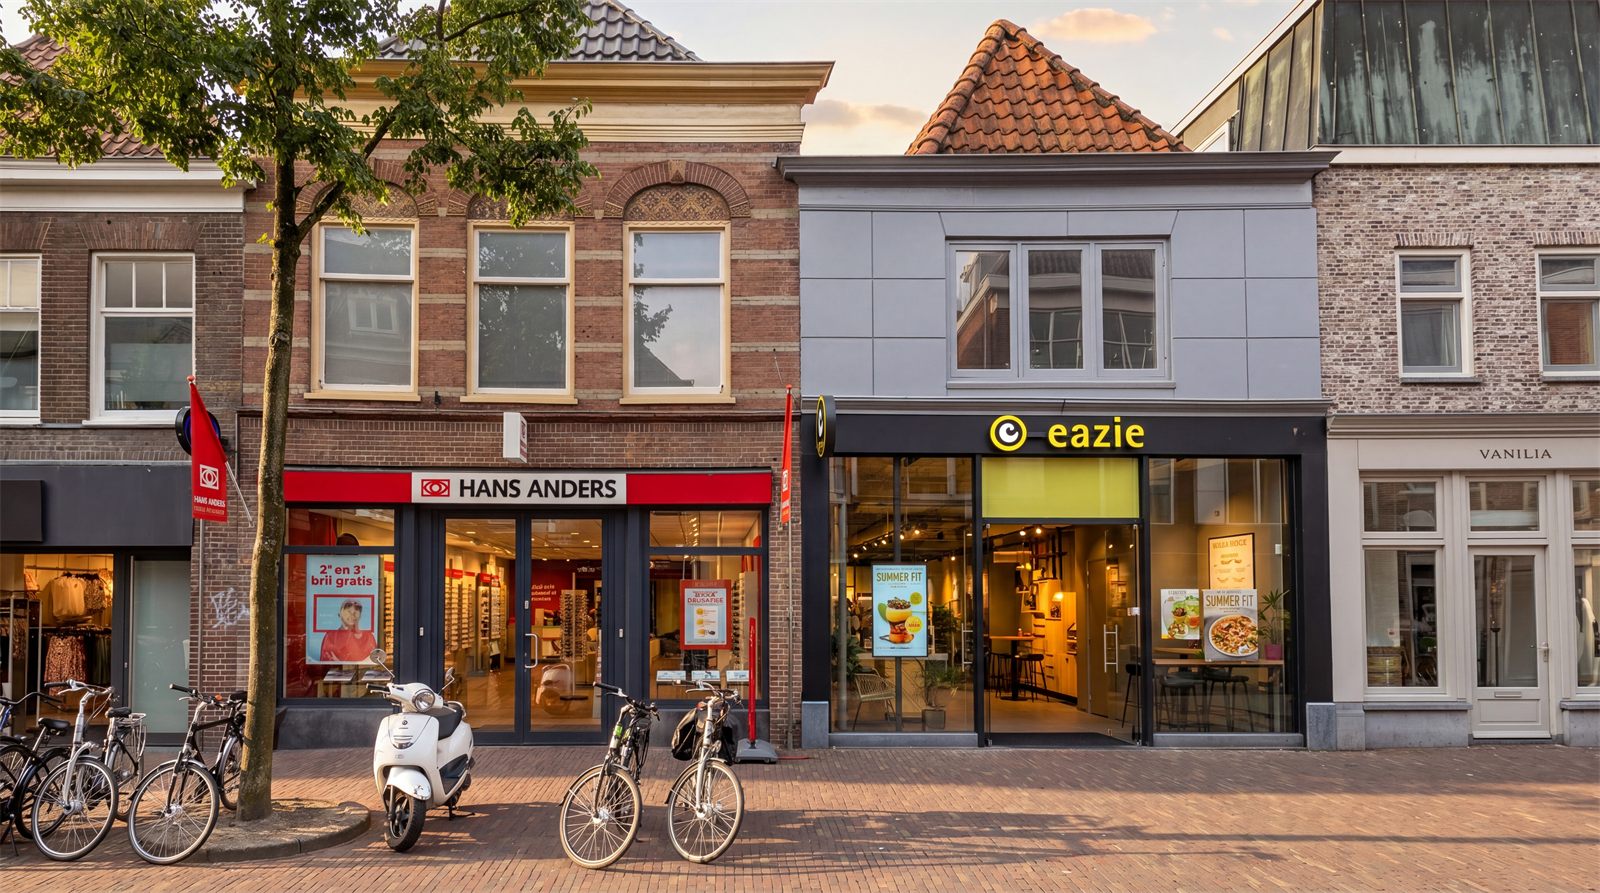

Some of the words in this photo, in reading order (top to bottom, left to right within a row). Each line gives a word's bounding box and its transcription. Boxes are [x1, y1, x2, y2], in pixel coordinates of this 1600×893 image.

[1048, 416, 1145, 448] eazie
[1479, 448, 1553, 460] VANILIA
[459, 478, 521, 498] HANS
[527, 478, 617, 499] ANDERS
[334, 566, 350, 575] en
[876, 572, 909, 582] SUMMER
[911, 572, 923, 582] FIT
[336, 575, 373, 588] gratis
[1205, 594, 1239, 607] SUMMER
[1242, 594, 1254, 607] FIT
